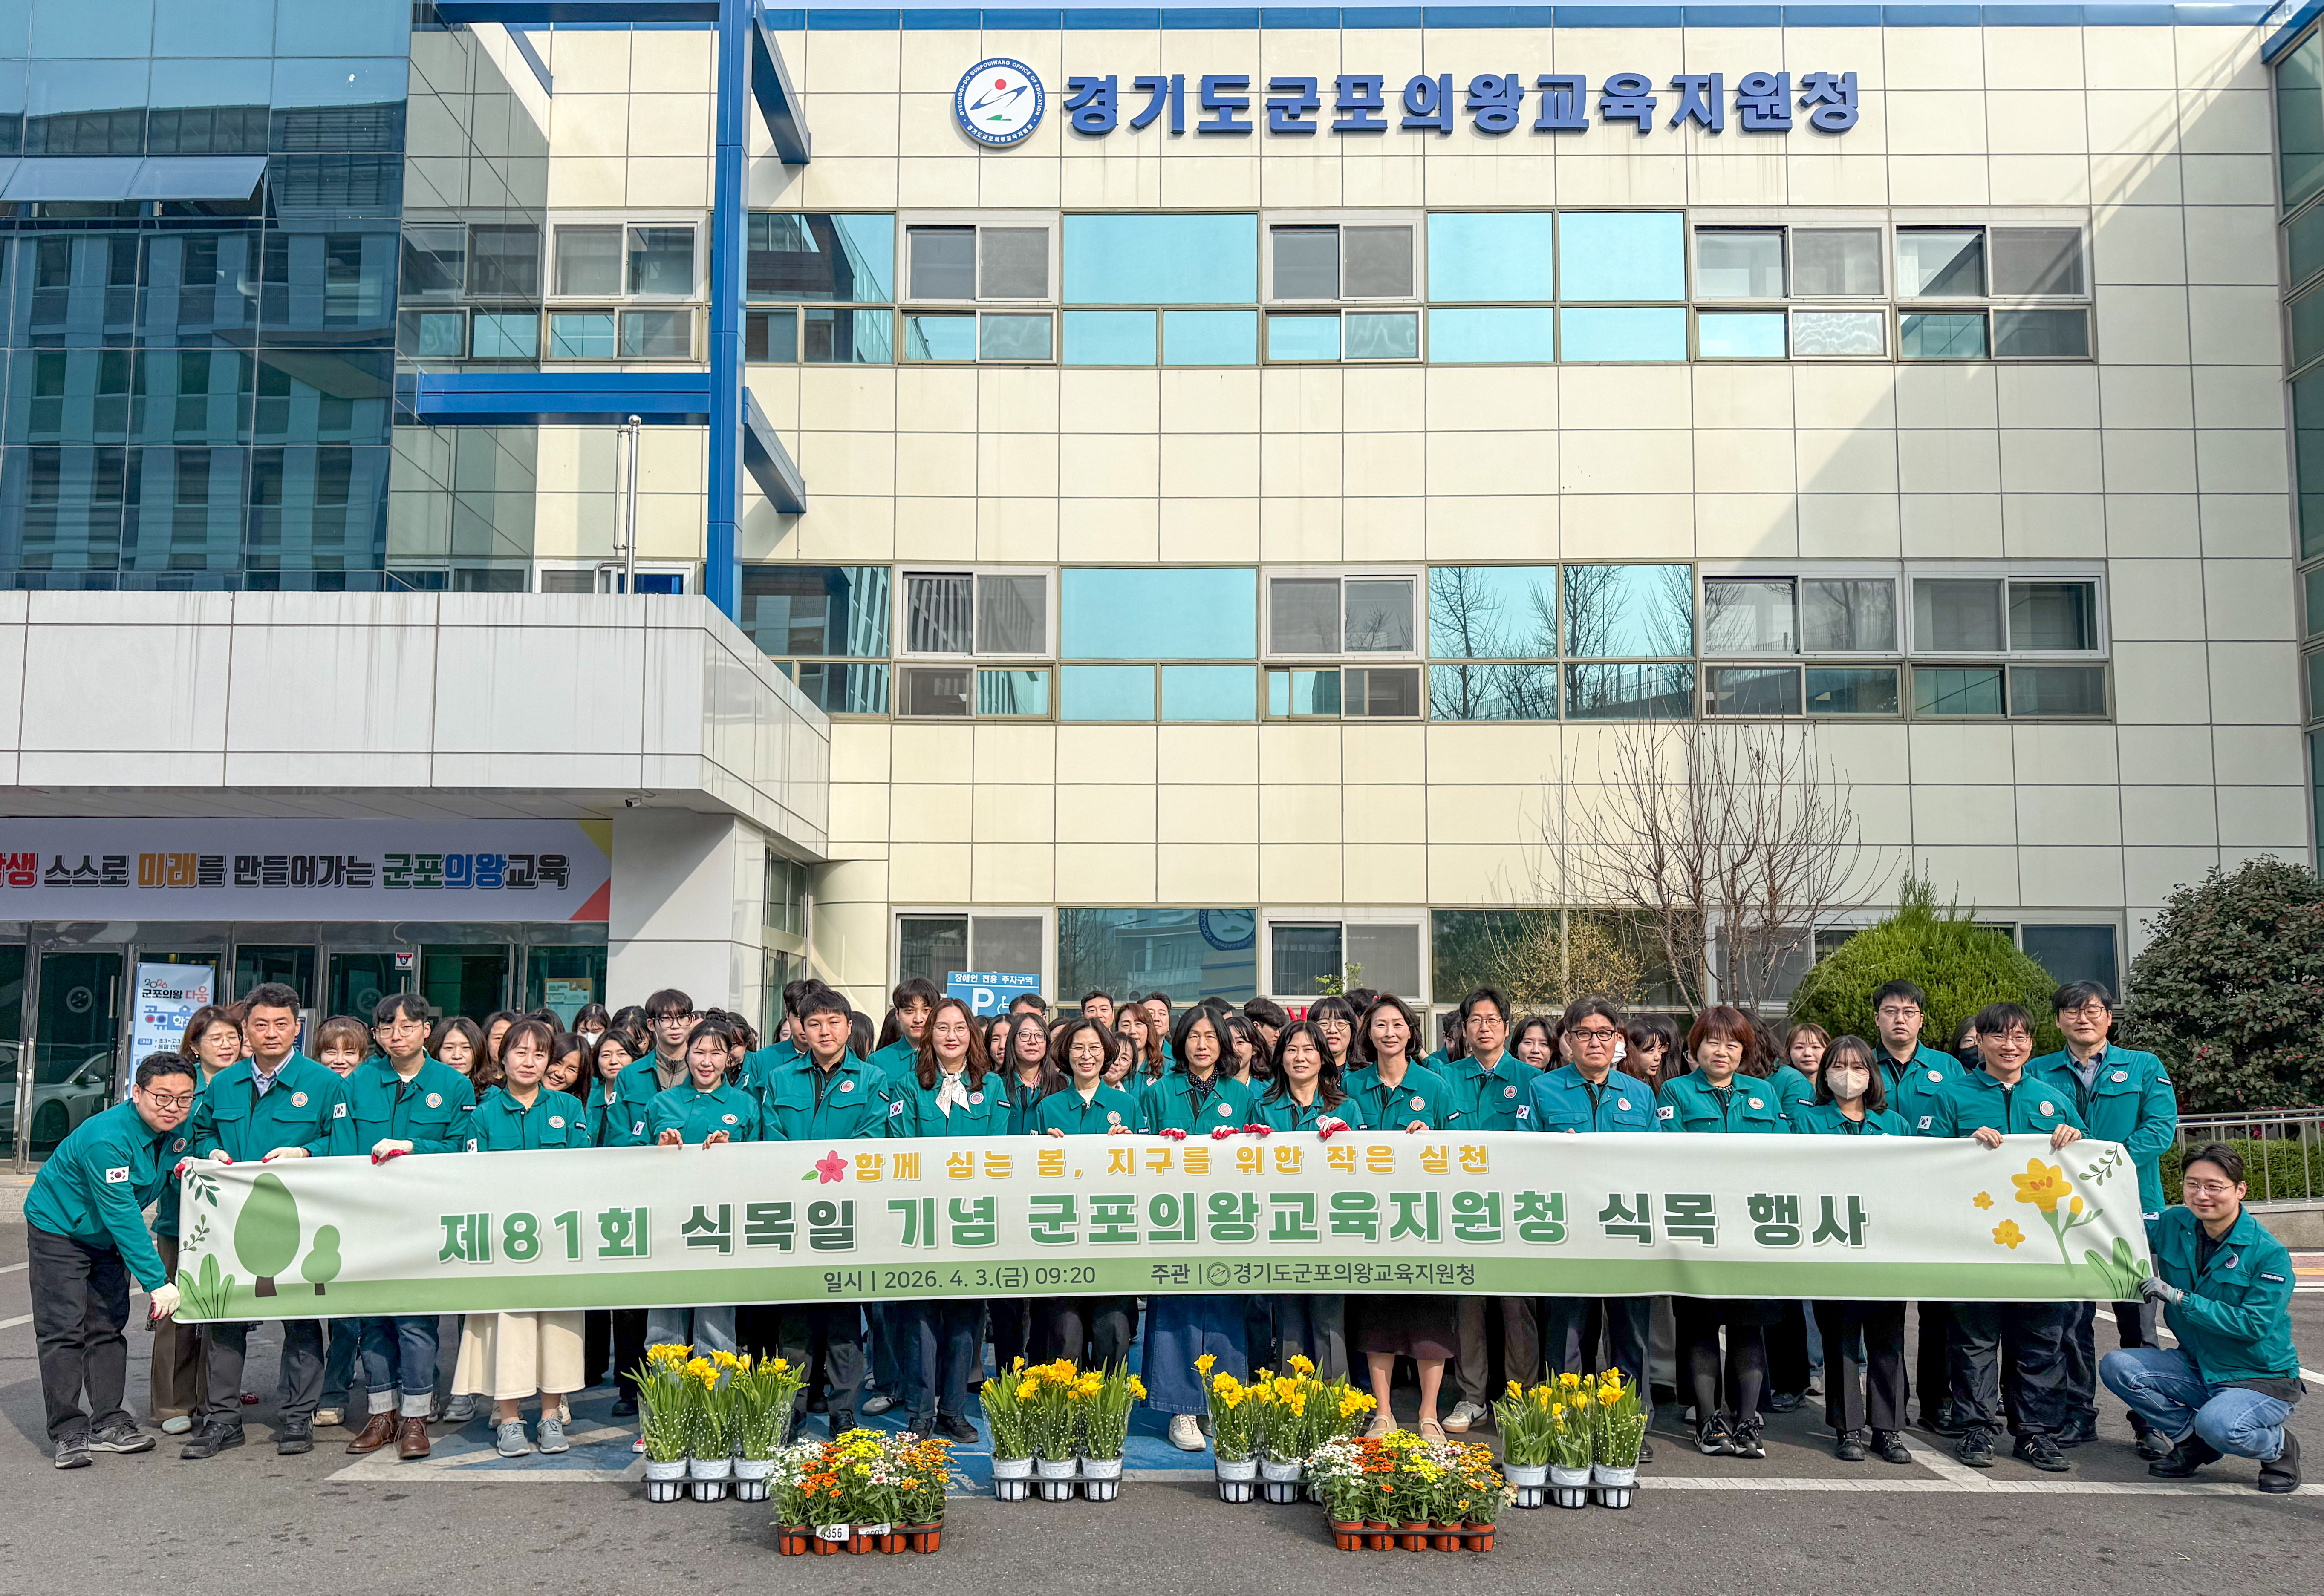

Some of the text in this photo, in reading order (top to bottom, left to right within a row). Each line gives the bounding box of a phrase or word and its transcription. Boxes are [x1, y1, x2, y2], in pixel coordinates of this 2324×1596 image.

[958, 76, 970, 115] GYEONGGI-DO
[970, 60, 1010, 76] GUNPOUIWANG
[1012, 63, 1031, 75] OFFICE
[1035, 84, 1043, 116] EDUCATION
[1065, 71, 1859, 135] 경기도군포의왕교육지원청
[44, 854, 129, 886] 스스로
[138, 853, 226, 887] 미래를
[234, 854, 374, 887] 만들어가는
[383, 853, 570, 889] 군포의왕교육
[144, 979, 167, 988] 2026
[955, 974, 1033, 985] 장애인 전용 주차구역
[142, 986, 209, 1003] 군포의왕 다움
[972, 988, 995, 1017] P
[855, 1144, 1488, 1181] 함께 심는 봄, 지구를 위한 작은 실천
[439, 1191, 1868, 1263] 제81회 식목일 기념 군포의왕교육지원청 식목 행사
[824, 1266, 1096, 1293] 일시 2026. 4. 3.(금) 09:20
[1151, 1263, 1190, 1285] 주관
[1233, 1262, 1475, 1286] 경기도군포의왕교육지원청
